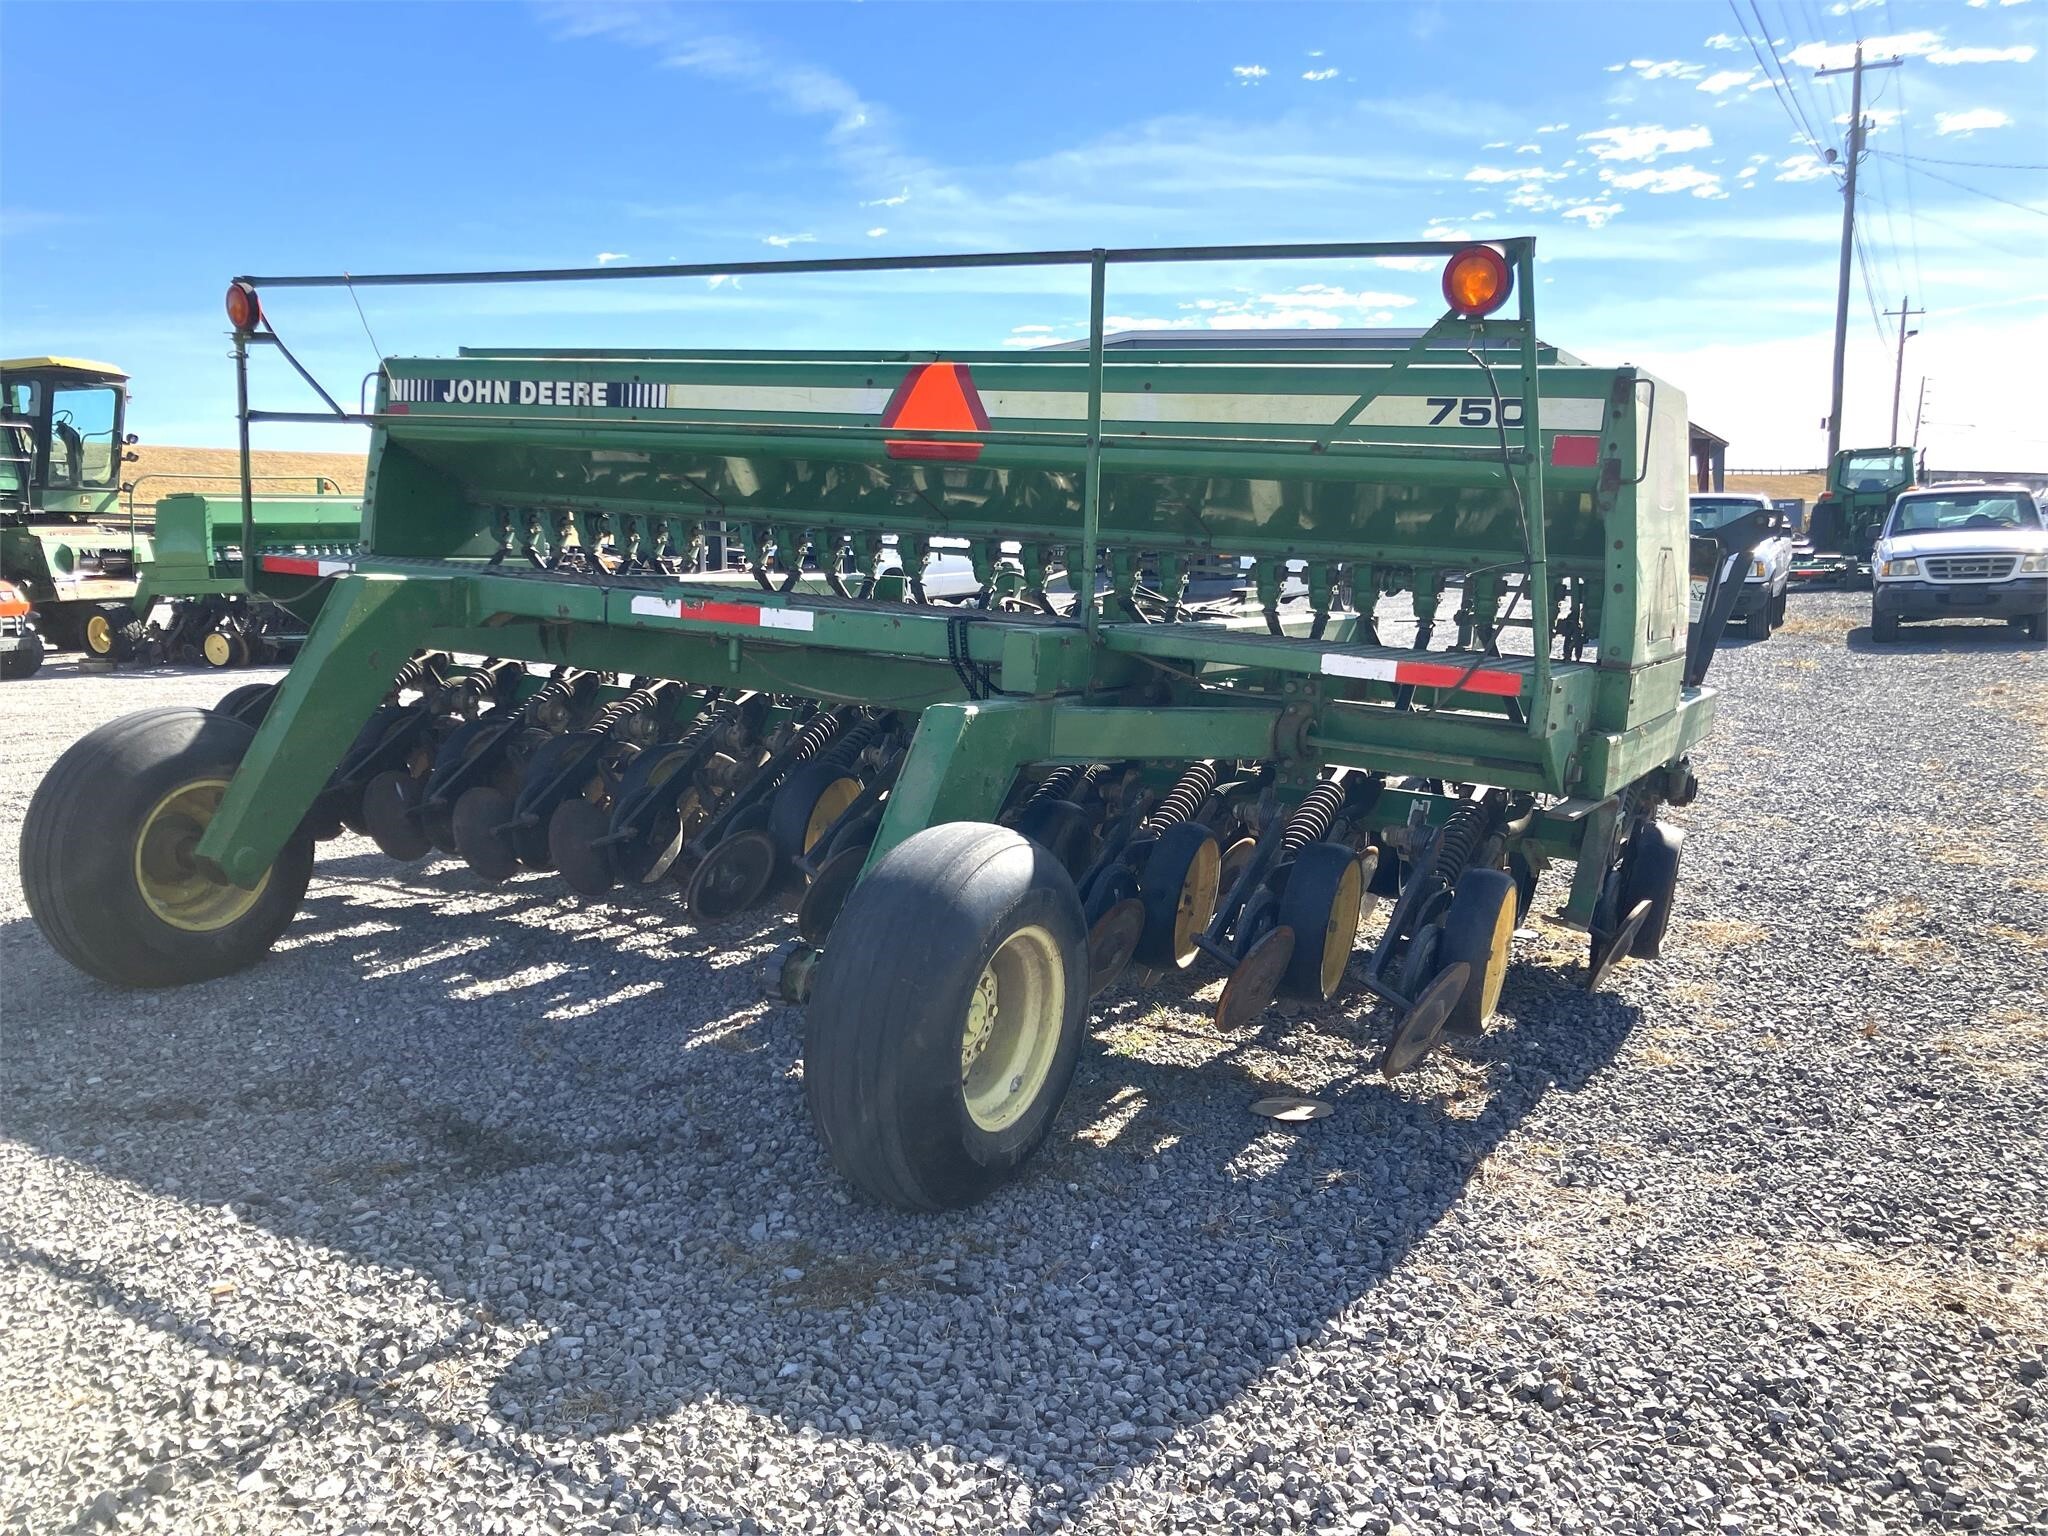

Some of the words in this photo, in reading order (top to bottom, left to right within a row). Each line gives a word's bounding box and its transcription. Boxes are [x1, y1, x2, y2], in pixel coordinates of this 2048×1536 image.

[443, 379, 511, 404] JOHN
[519, 381, 608, 407] DEERE
[1426, 397, 1525, 427] 750
